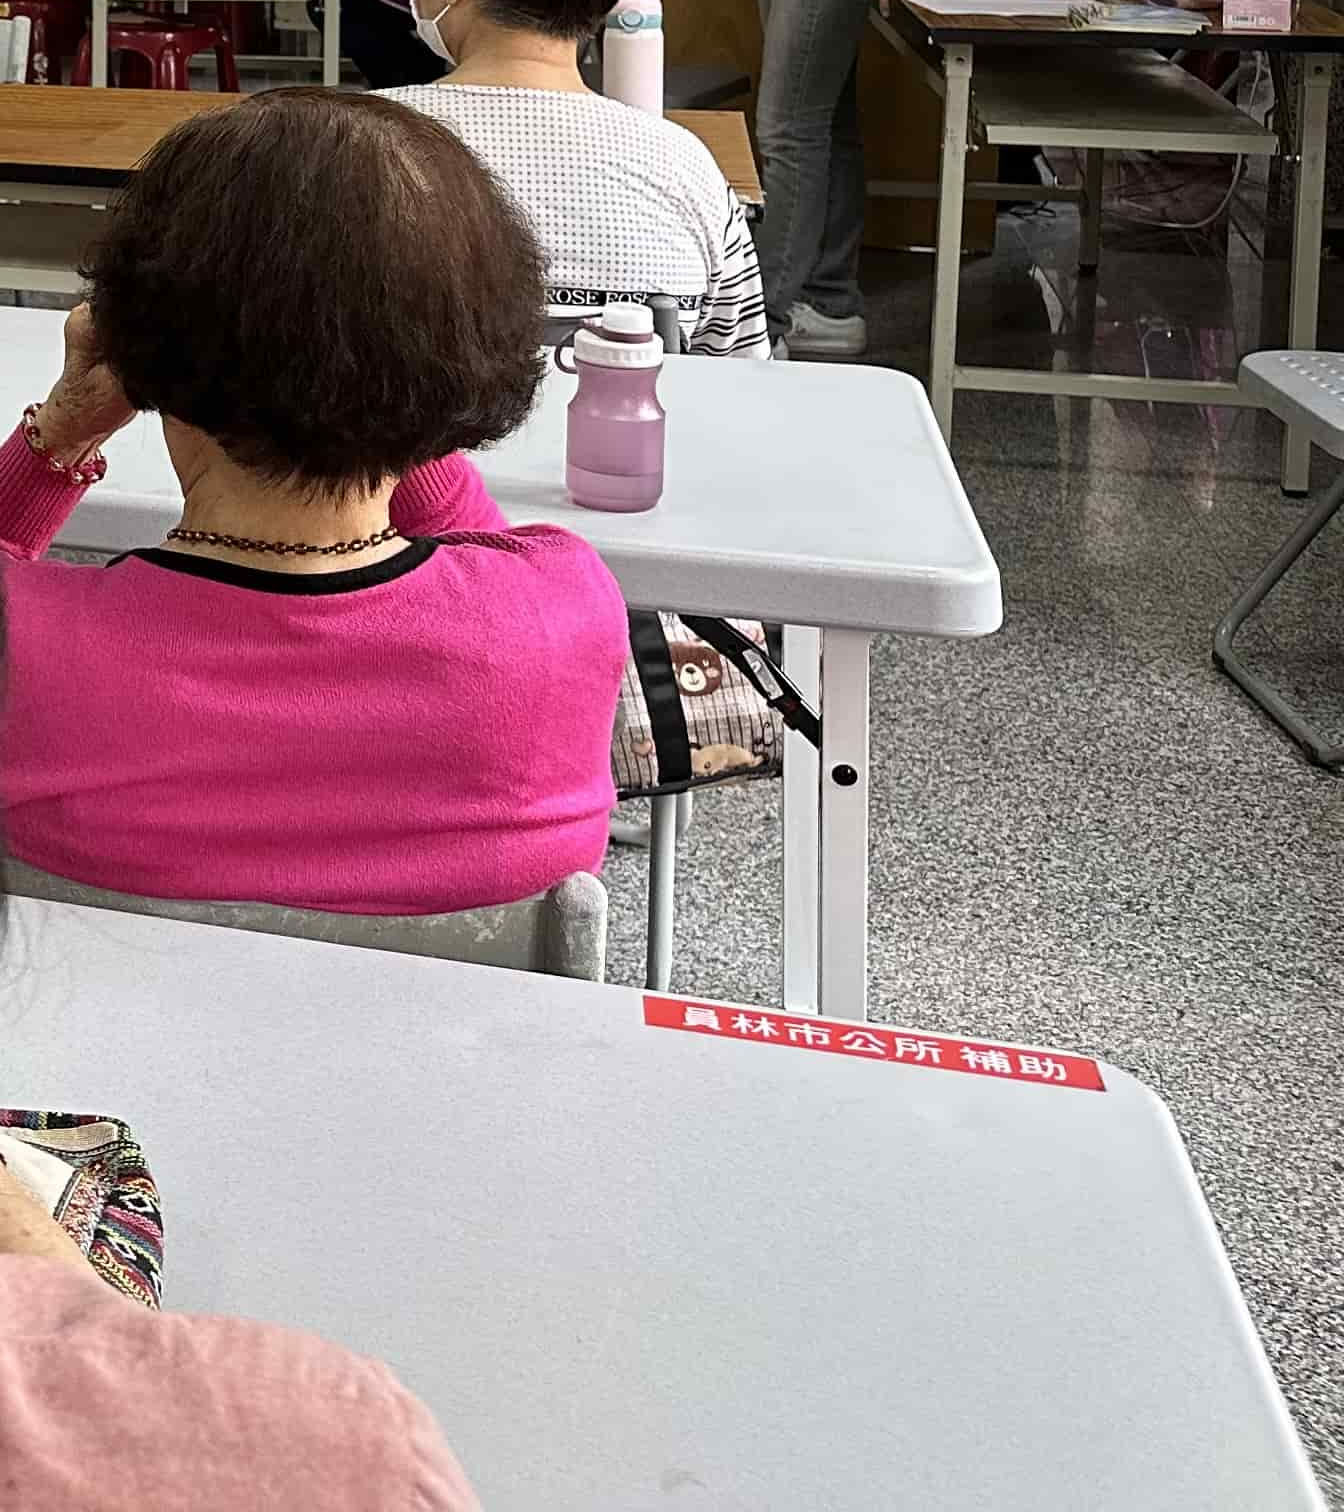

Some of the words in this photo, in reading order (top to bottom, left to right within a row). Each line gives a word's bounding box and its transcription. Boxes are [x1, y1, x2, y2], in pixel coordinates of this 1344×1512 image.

[544, 288, 599, 305] ROSE
[682, 1005, 943, 1064] 員林市公所
[961, 1045, 1070, 1082] 補助
